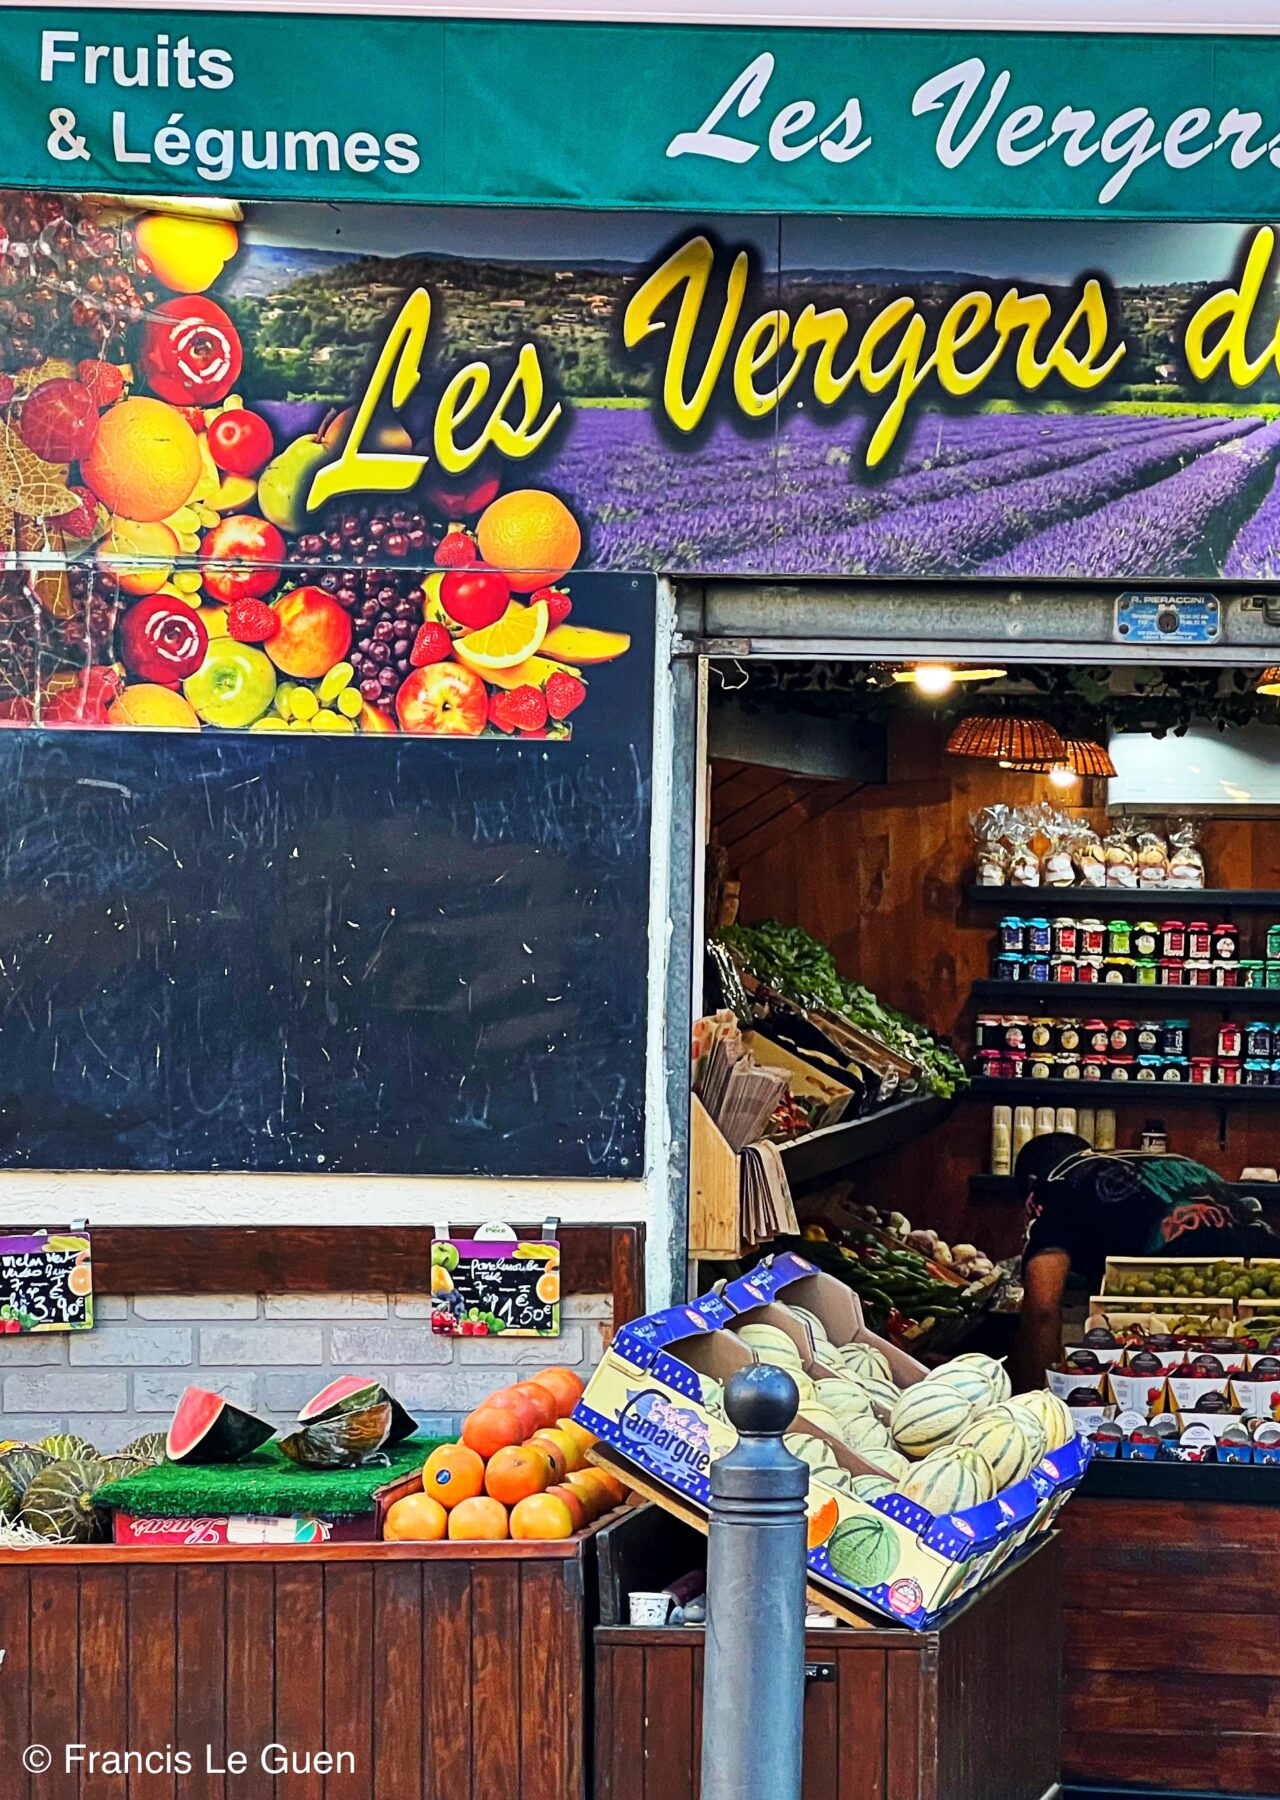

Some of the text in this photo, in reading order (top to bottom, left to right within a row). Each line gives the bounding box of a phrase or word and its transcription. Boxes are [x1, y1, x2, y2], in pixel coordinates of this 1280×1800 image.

[39, 29, 235, 91] Fruits
[47, 106, 421, 182] & Légumes
[666, 51, 873, 163] Les
[306, 286, 562, 512] Les
[622, 234, 1127, 468] Vergers
[1143, 596, 1206, 604] PIERACCINI
[618, 1388, 711, 1472] Camargue
